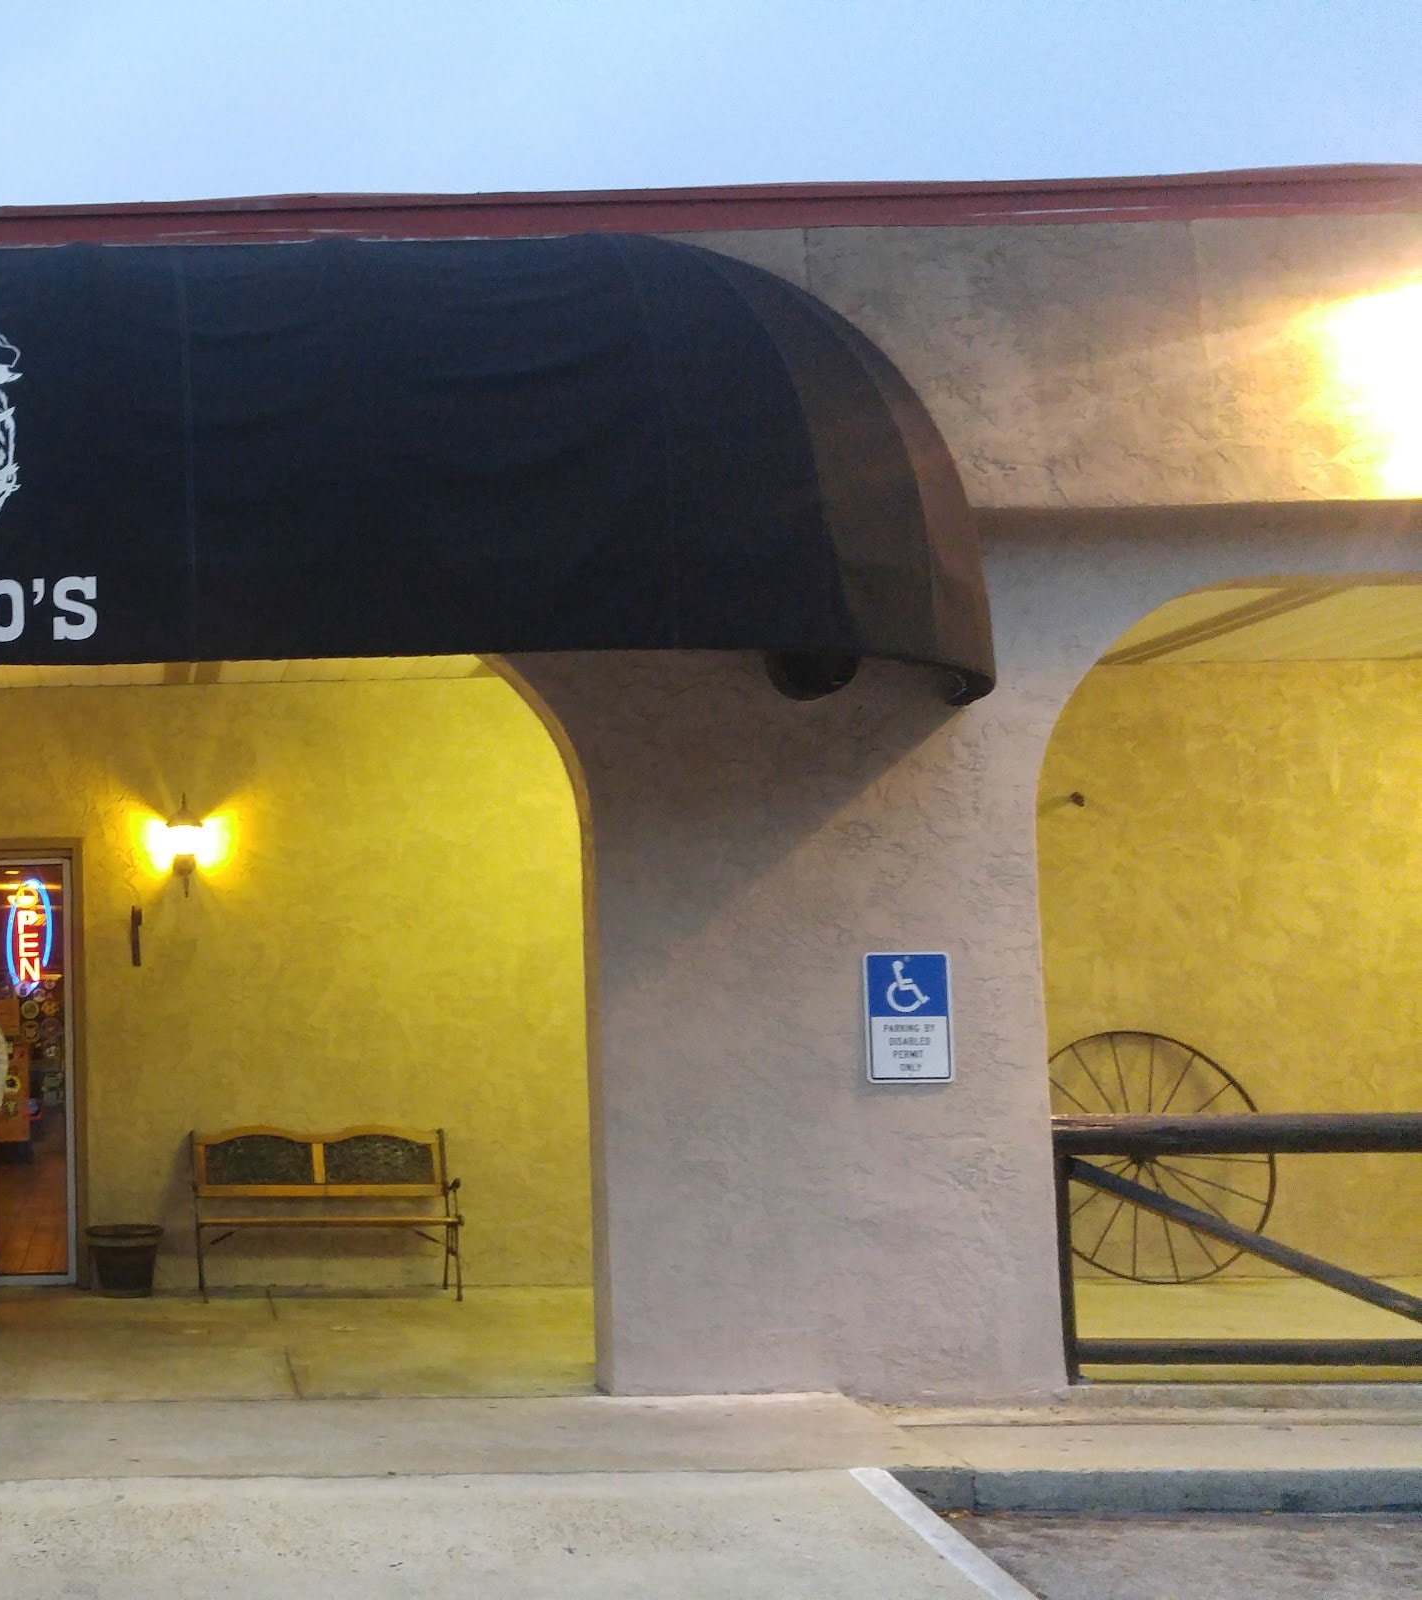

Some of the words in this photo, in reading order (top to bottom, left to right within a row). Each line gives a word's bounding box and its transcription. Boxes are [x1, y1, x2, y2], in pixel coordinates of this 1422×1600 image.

[15, 886, 41, 982] OPEN
[882, 1024, 919, 1032] PARKING
[924, 1024, 935, 1032] BY
[889, 1037, 931, 1046] DISABLED
[892, 1050, 923, 1059] PERMIT
[899, 1063, 922, 1072] ONLY
